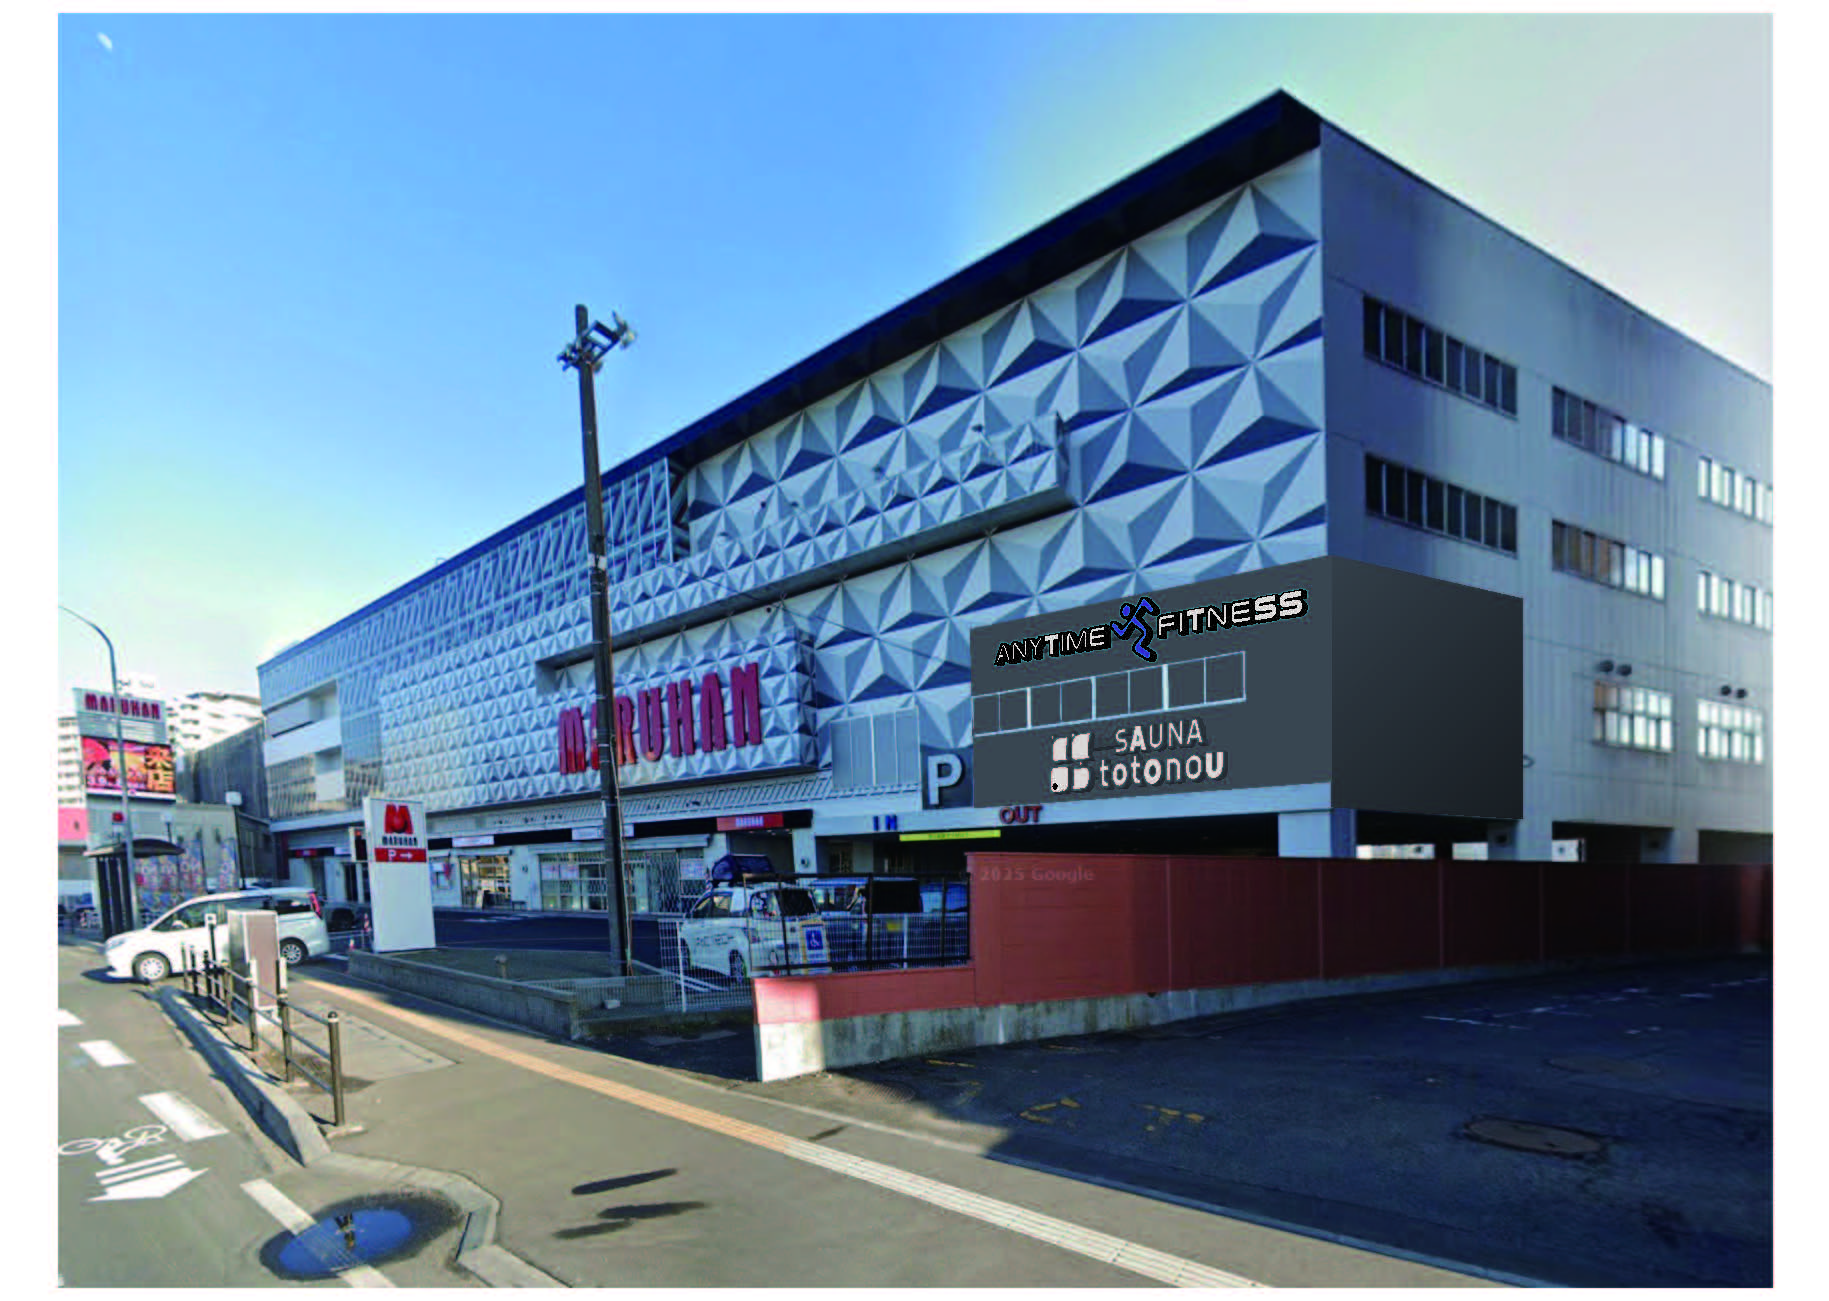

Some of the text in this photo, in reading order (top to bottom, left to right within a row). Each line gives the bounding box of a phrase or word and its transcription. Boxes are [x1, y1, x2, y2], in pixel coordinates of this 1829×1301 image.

[995, 589, 1304, 664] ANYTIME FITNESS
[1115, 719, 1203, 753] SAUNA
[928, 753, 963, 805] P
[872, 814, 898, 831] IN
[1000, 805, 1043, 824] OUT
[387, 849, 397, 862] P
